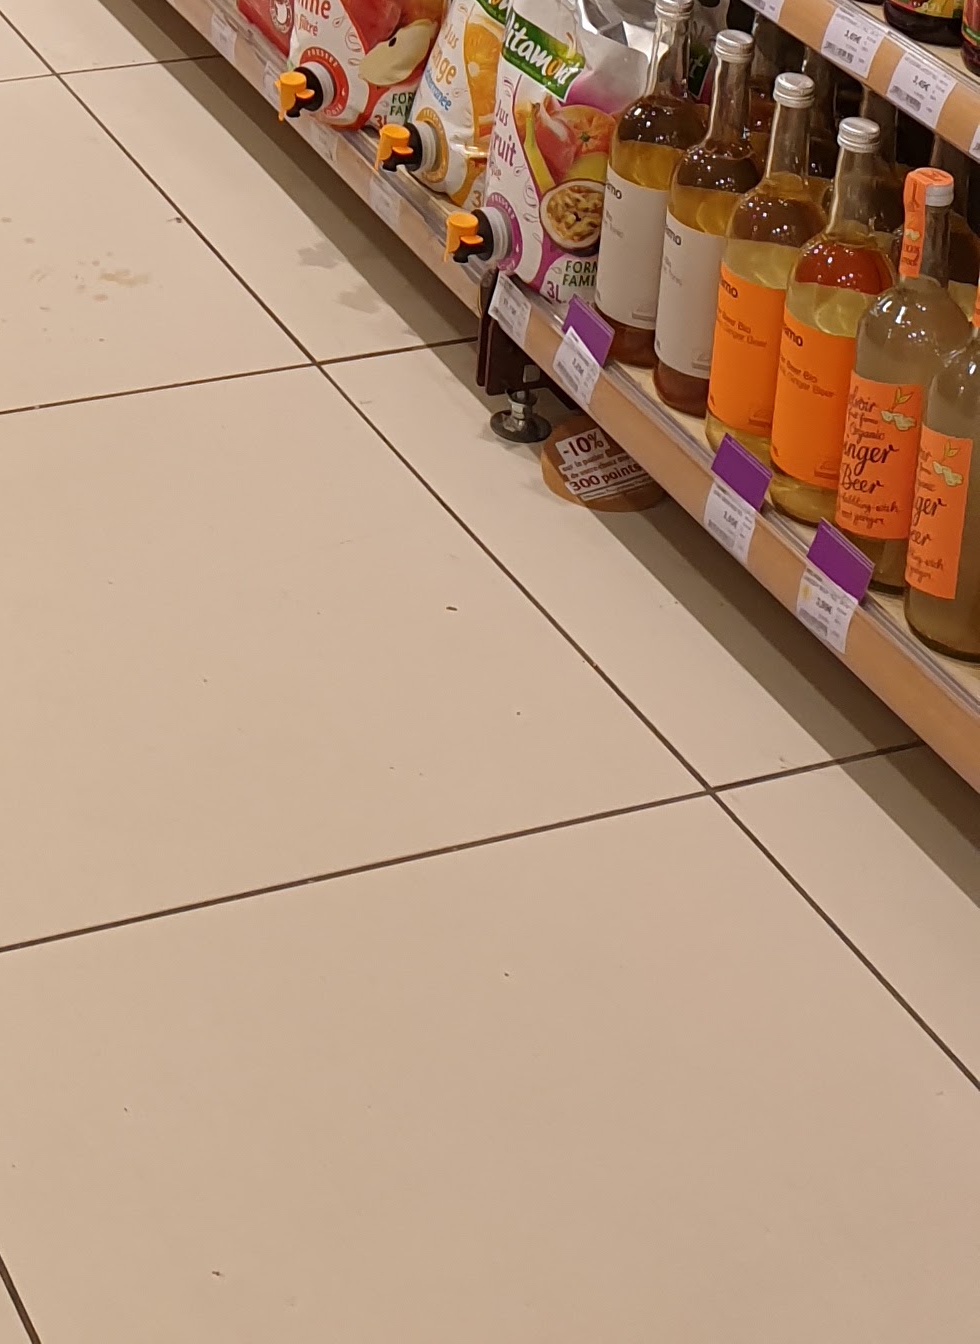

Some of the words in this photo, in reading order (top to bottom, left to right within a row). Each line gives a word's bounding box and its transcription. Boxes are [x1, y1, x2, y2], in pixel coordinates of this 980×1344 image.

[297, 15, 319, 37] filtré
[431, 50, 458, 85] ange
[391, 91, 415, 105] FOR
[492, 131, 517, 167] ruit
[562, 273, 596, 287] FAMI
[565, 260, 598, 274] FORM
[562, 431, 604, 457] -10%
[843, 433, 900, 477] inger
[570, 474, 601, 492] 300
[601, 462, 643, 485] points
[841, 463, 885, 494] Beer
[913, 495, 947, 526] ger
[911, 530, 933, 548] eer
